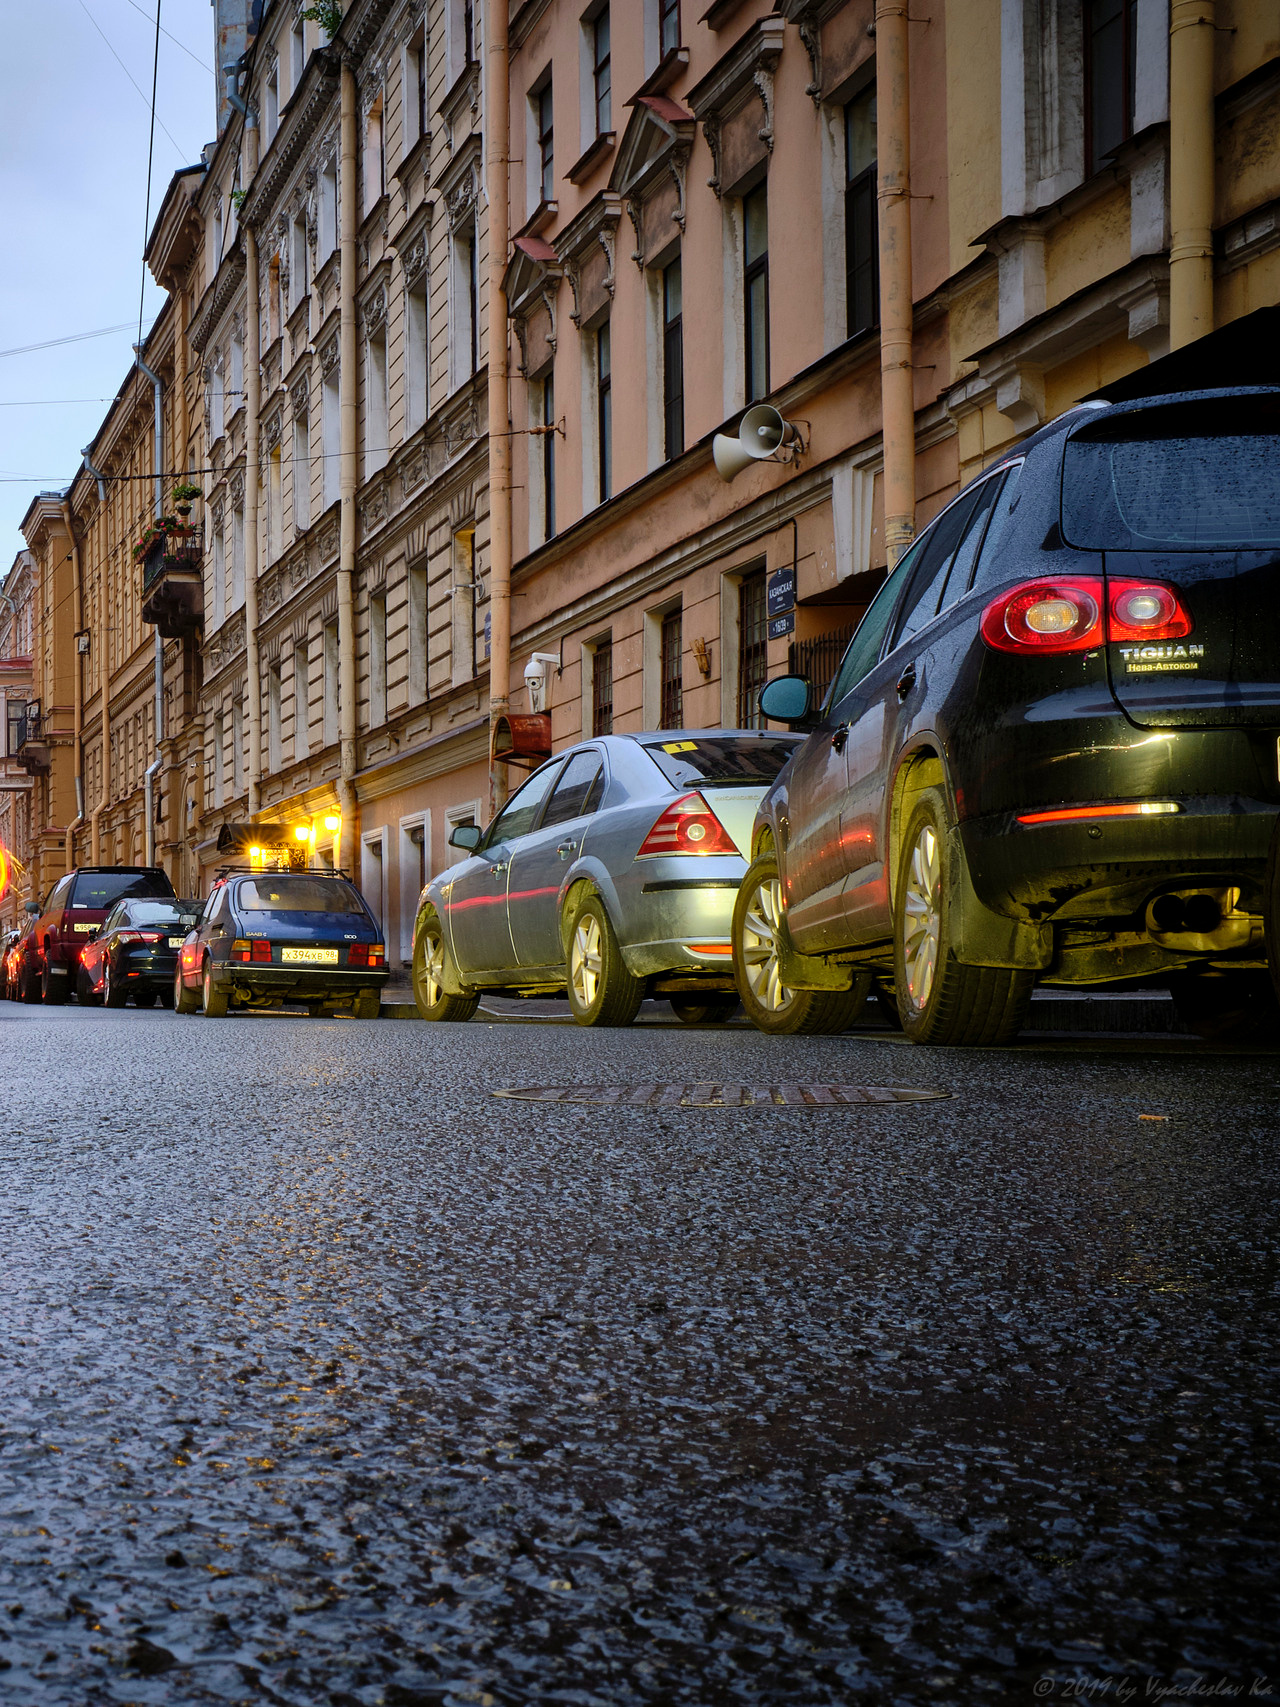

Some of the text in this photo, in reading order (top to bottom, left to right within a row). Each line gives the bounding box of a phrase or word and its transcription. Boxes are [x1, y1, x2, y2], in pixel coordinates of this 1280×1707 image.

[769, 581, 792, 599] КАЗАНСКАЯ
[1119, 644, 1204, 661] TIGUAN
[1128, 662, 1199, 672] Нева-Автоком
